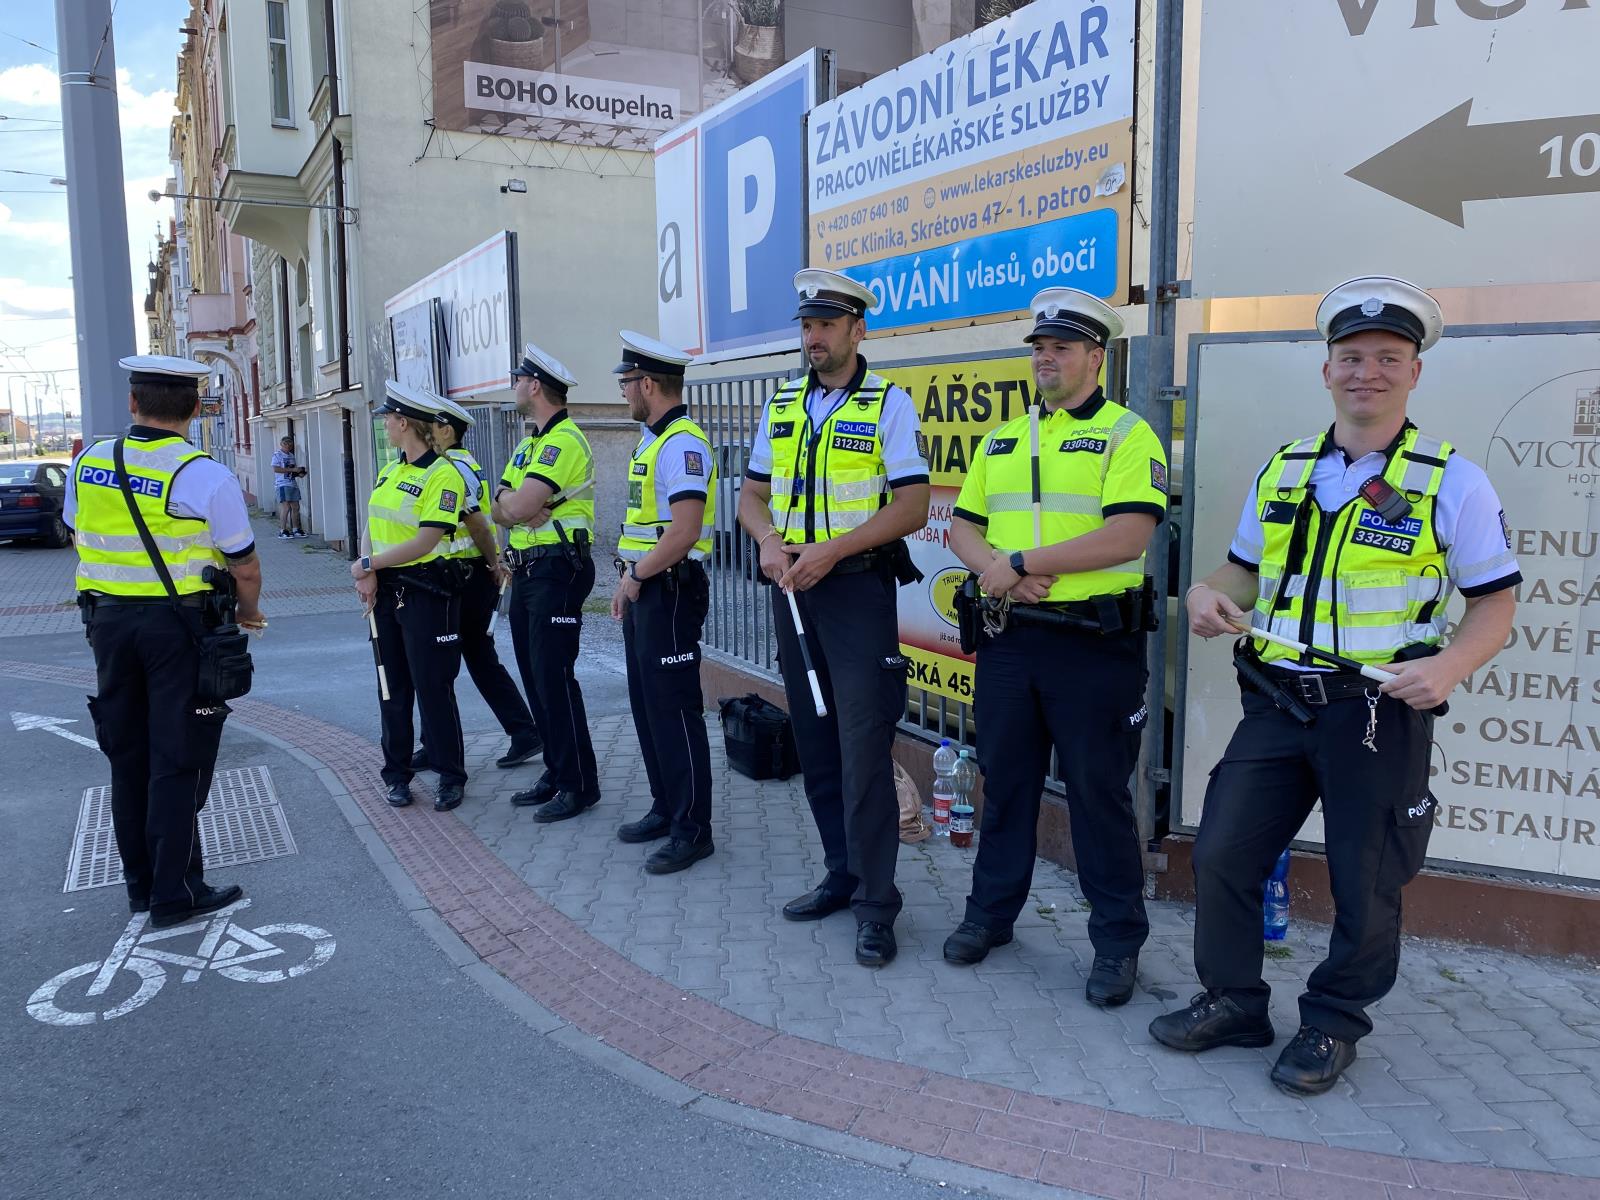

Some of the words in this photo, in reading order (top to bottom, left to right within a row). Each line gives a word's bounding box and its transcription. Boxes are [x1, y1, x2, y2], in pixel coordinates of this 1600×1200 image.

[476, 75, 557, 105] BOHO
[565, 85, 674, 120] koupelna
[816, 51, 955, 165] ZÁVODNÍ
[967, 0, 1109, 107] LÉKAŘ
[816, 103, 1004, 200] PRACOVNĚLÉKAŘSKÉ
[1011, 74, 1110, 136] SLUŽBY
[940, 142, 1109, 202] www.lekarskesluzby.eu
[727, 135, 776, 313] P
[828, 214, 849, 232] +420
[850, 209, 868, 227] 607
[869, 202, 888, 221] 640
[891, 196, 909, 215] 180
[836, 239, 858, 261] EUC
[861, 228, 908, 255] Klinika,
[911, 211, 977, 243] Skrétova
[982, 201, 1002, 225] 47
[1018, 195, 1032, 217] 1.
[1037, 184, 1091, 219] patro
[862, 247, 961, 316] OVÁNÍ
[966, 252, 1026, 290] vlasů,
[1032, 237, 1097, 279] obočí
[900, 374, 1043, 422] ÁŘSTV
[836, 421, 876, 434] POLICIE
[834, 437, 873, 452] 312288
[1062, 439, 1103, 452] 330563
[80, 466, 161, 496] POLCIE
[928, 503, 953, 522] AKÁ
[1361, 511, 1421, 533] POLCIE
[1355, 530, 1411, 552] 332795
[1509, 529, 1599, 558] ENU
[1514, 575, 1600, 606] ASÁ
[551, 616, 577, 624] POLICIE
[661, 652, 694, 665] POLICIE
[1433, 804, 1600, 846] RESTAUR
